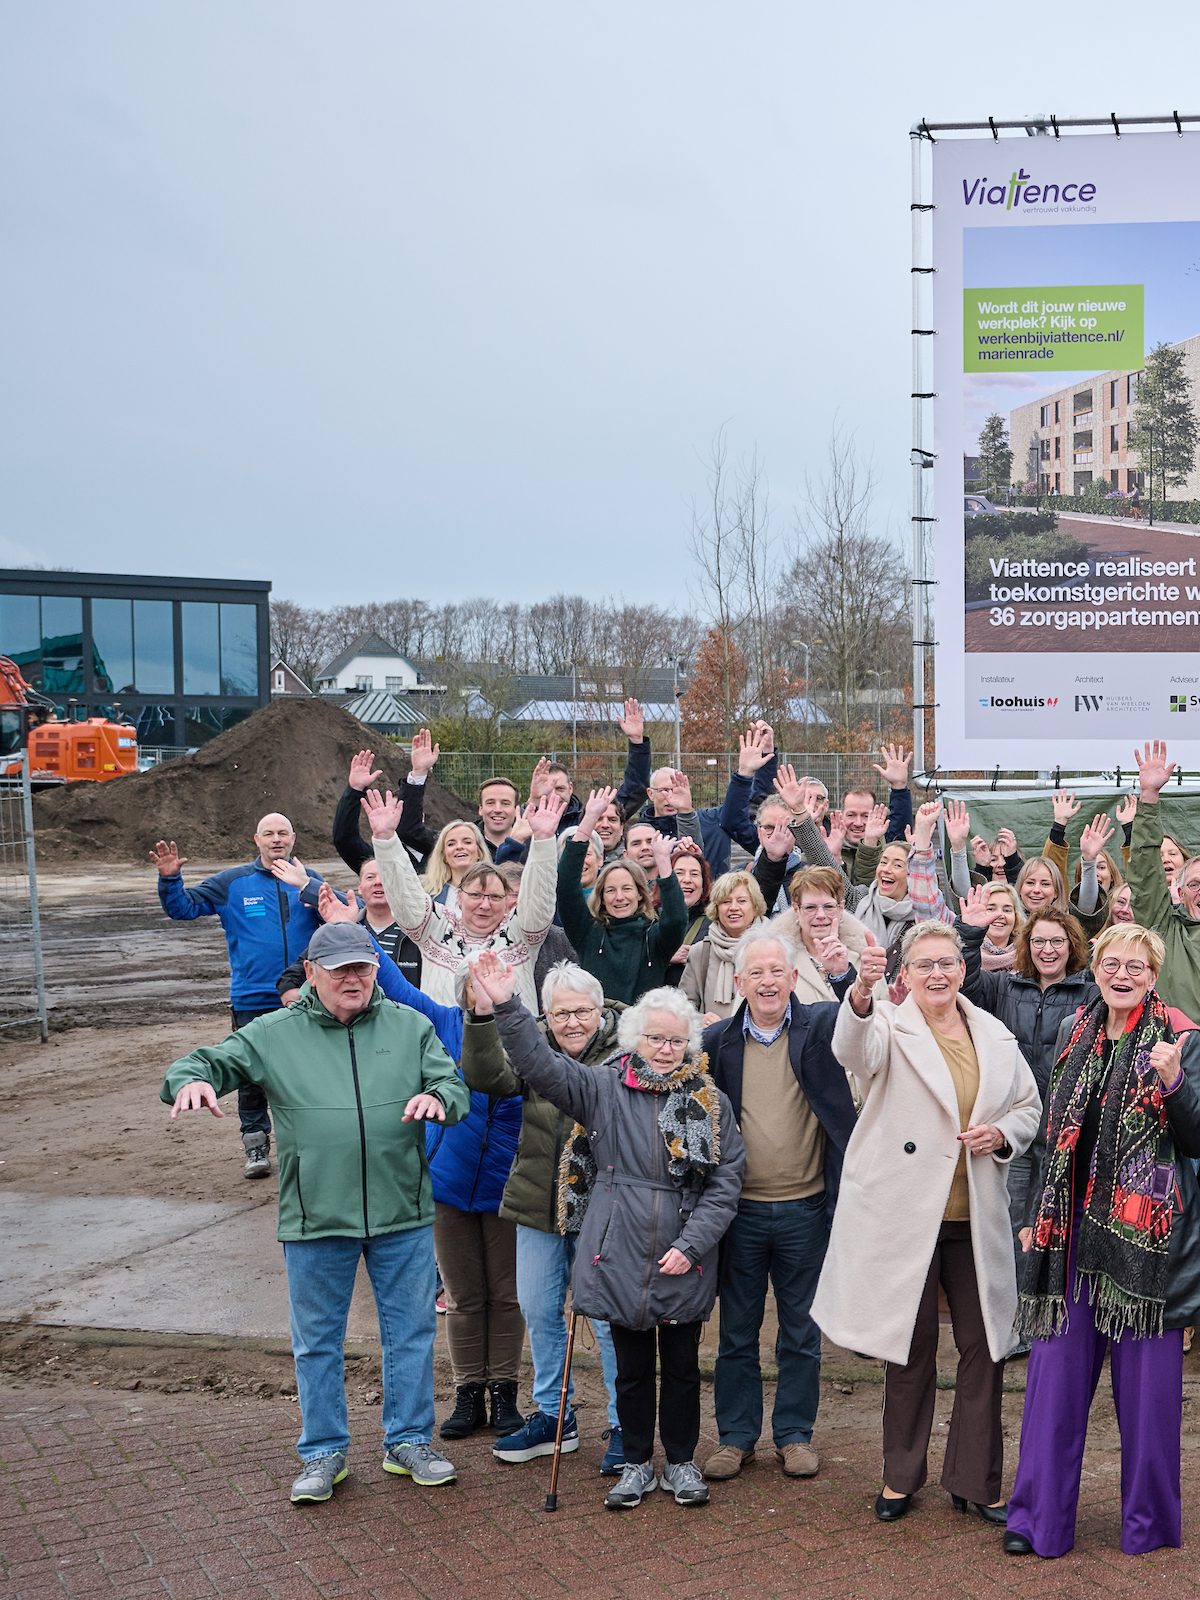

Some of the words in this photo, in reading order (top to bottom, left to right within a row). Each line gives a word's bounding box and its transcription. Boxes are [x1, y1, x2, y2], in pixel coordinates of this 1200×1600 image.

[963, 168, 1097, 211] Viattence
[1060, 204, 1097, 213] vakkundig
[977, 301, 1019, 314] Wordt
[1021, 300, 1039, 314] dit
[1041, 300, 1075, 316] jouw
[1077, 299, 1127, 312] nieuwe
[977, 316, 1047, 332] werkplek?
[1050, 315, 1077, 331] Kijk
[1079, 316, 1098, 330] op
[977, 329, 1125, 346] werkenbijviattence.nl/
[977, 347, 1055, 360] marienrade
[988, 557, 1090, 578] Viattence
[1095, 557, 1197, 577] realiseert
[988, 582, 1180, 606] toekomstgerichte
[989, 606, 1016, 627] 36
[980, 675, 1015, 683] Installateur
[1074, 675, 1104, 683] Architect
[1169, 675, 1199, 684] Adviseur
[990, 696, 1045, 708] loohuis
